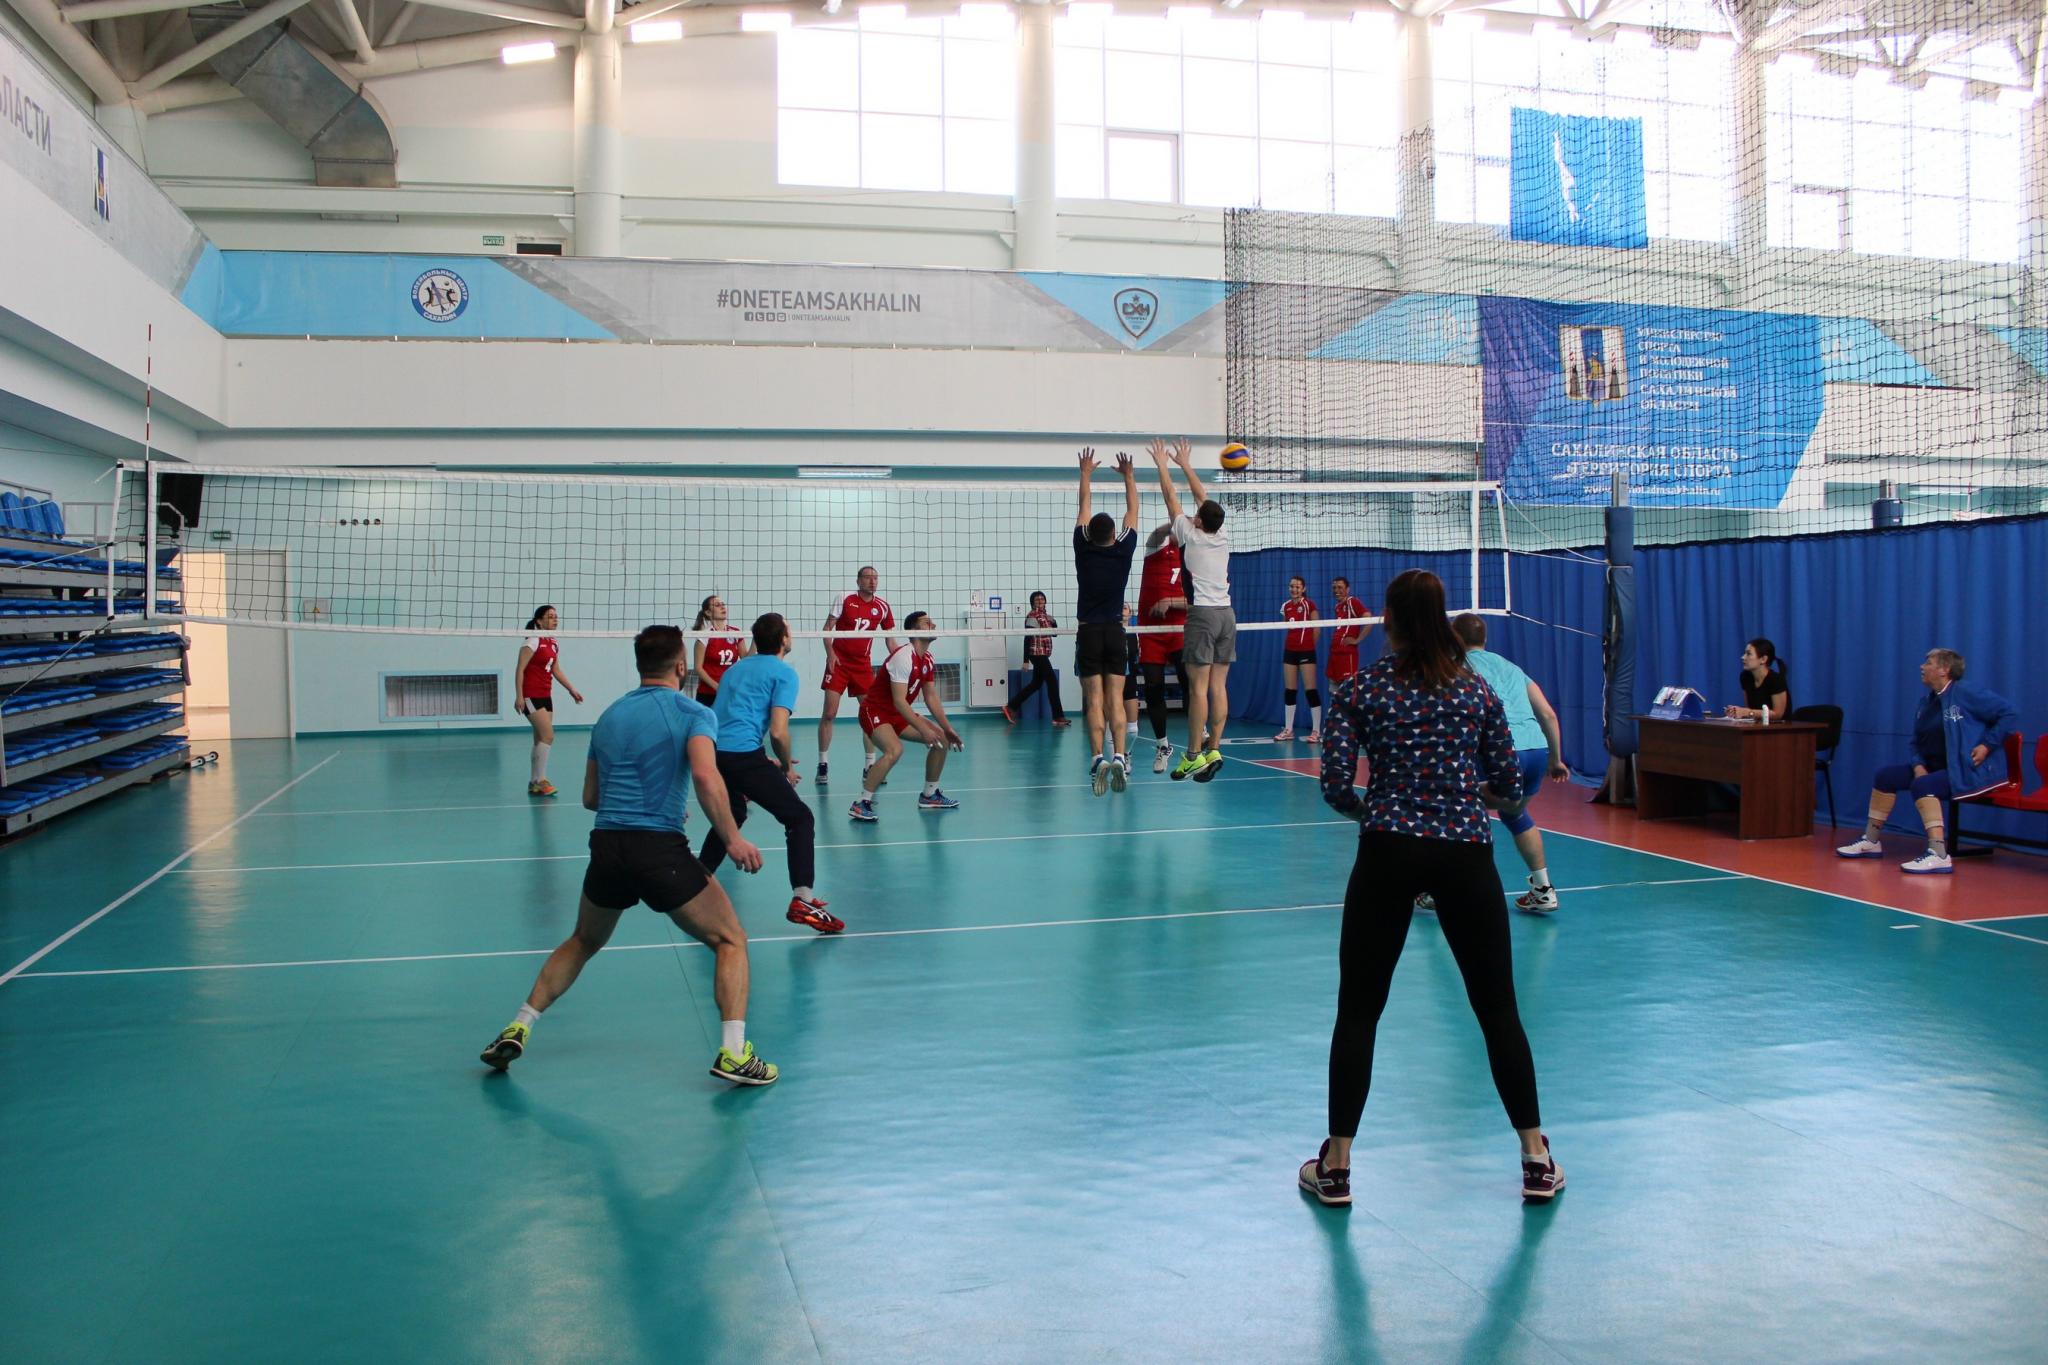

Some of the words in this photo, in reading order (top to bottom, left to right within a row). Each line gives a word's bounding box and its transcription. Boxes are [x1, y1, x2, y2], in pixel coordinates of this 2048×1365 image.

[0, 74, 51, 156] ЛАСТИ
[717, 289, 921, 313] #ONETEAMSAKHALIN
[1551, 443, 1666, 459] САХАЛИНСКАЯ
[1670, 446, 1738, 461] ОБЛАСТЬ
[1674, 464, 1732, 478] СПОРТА
[854, 618, 870, 631] 12
[718, 649, 734, 666] 12
